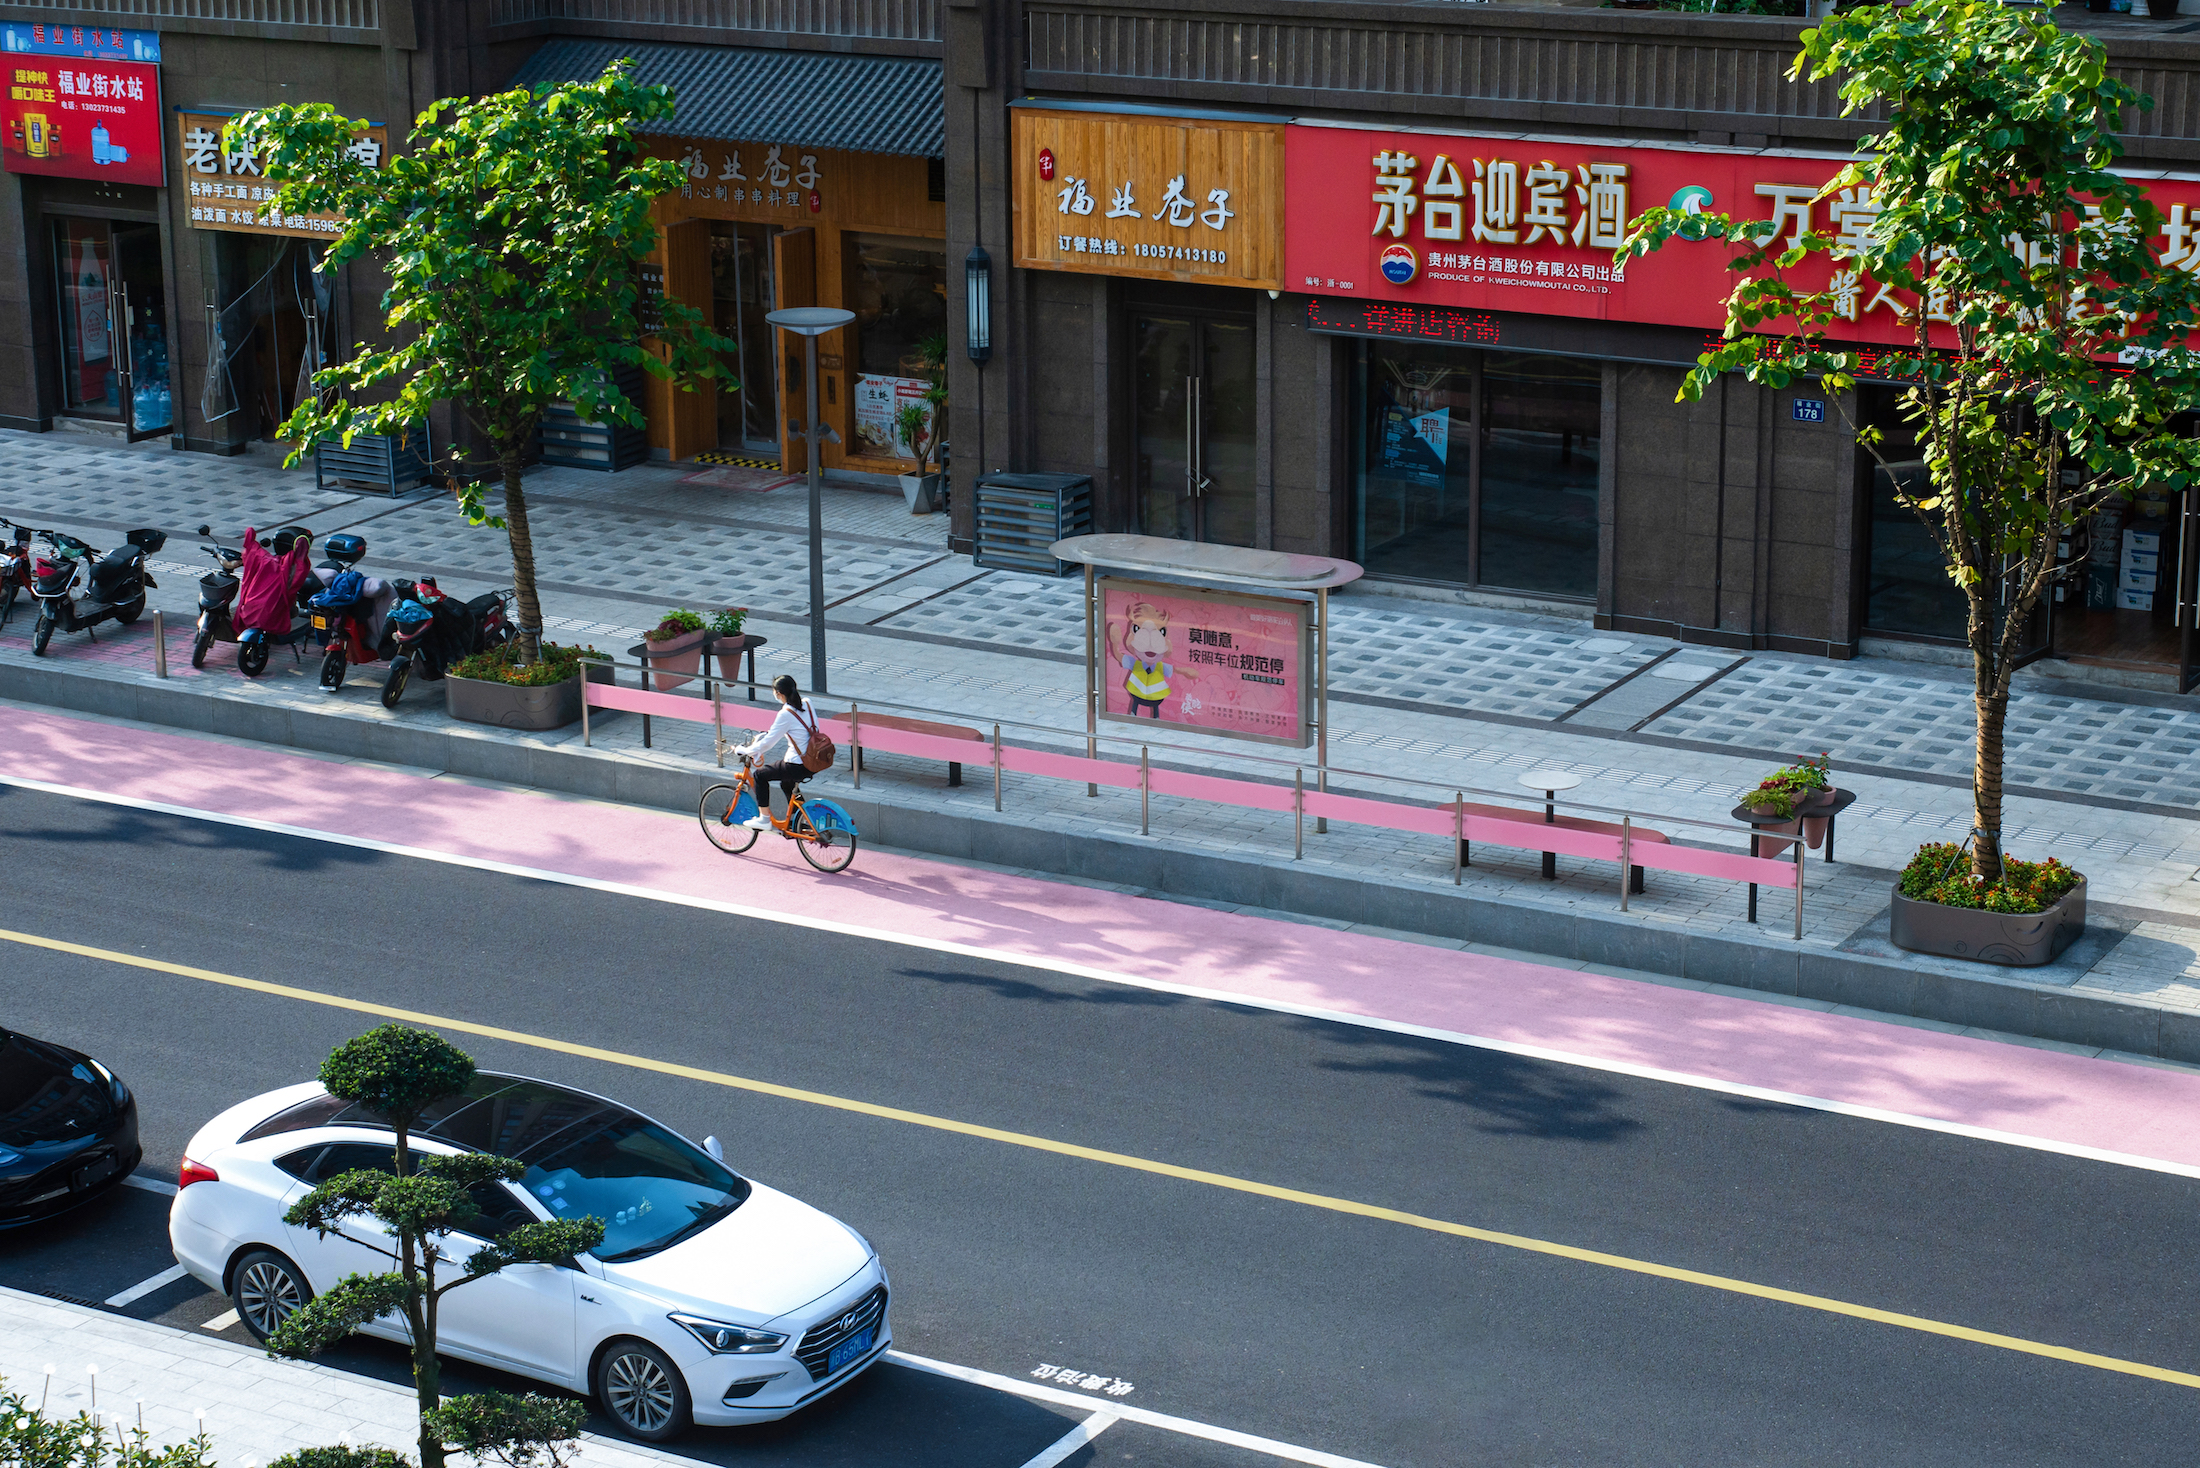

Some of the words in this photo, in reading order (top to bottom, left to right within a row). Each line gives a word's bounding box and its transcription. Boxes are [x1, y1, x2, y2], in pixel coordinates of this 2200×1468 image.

[32, 23, 124, 49] 福业街水站
[15, 69, 49, 85] 提神快
[58, 69, 144, 101] 福业街水站
[680, 145, 822, 190] 福业巷子
[190, 181, 248, 200] 各种手工面
[680, 183, 801, 207] 用心制串串料理
[1057, 174, 1235, 231] 福业巷子
[1372, 148, 1630, 250] 茅台迎宾酒
[191, 206, 227, 223] 油泼面
[231, 209, 254, 226] 水饺
[284, 214, 344, 233] 电话:15968
[1058, 235, 1226, 264] 订餐热线：18057413180
[1427, 252, 1625, 283] 贵州茅台酒股份有限公司出品
[1428, 271, 1470, 283] PRODUCE
[1473, 275, 1485, 283] OF
[1489, 277, 1571, 291] KWEICHOWMOUTAI
[1798, 408, 1817, 419] 178
[1420, 418, 1444, 443] 聘
[2093, 518, 2118, 529] Bud
[2092, 540, 2116, 553] Bud
[1188, 627, 1239, 651] 莫随意，
[1188, 648, 1284, 674] 按照车位规范停
